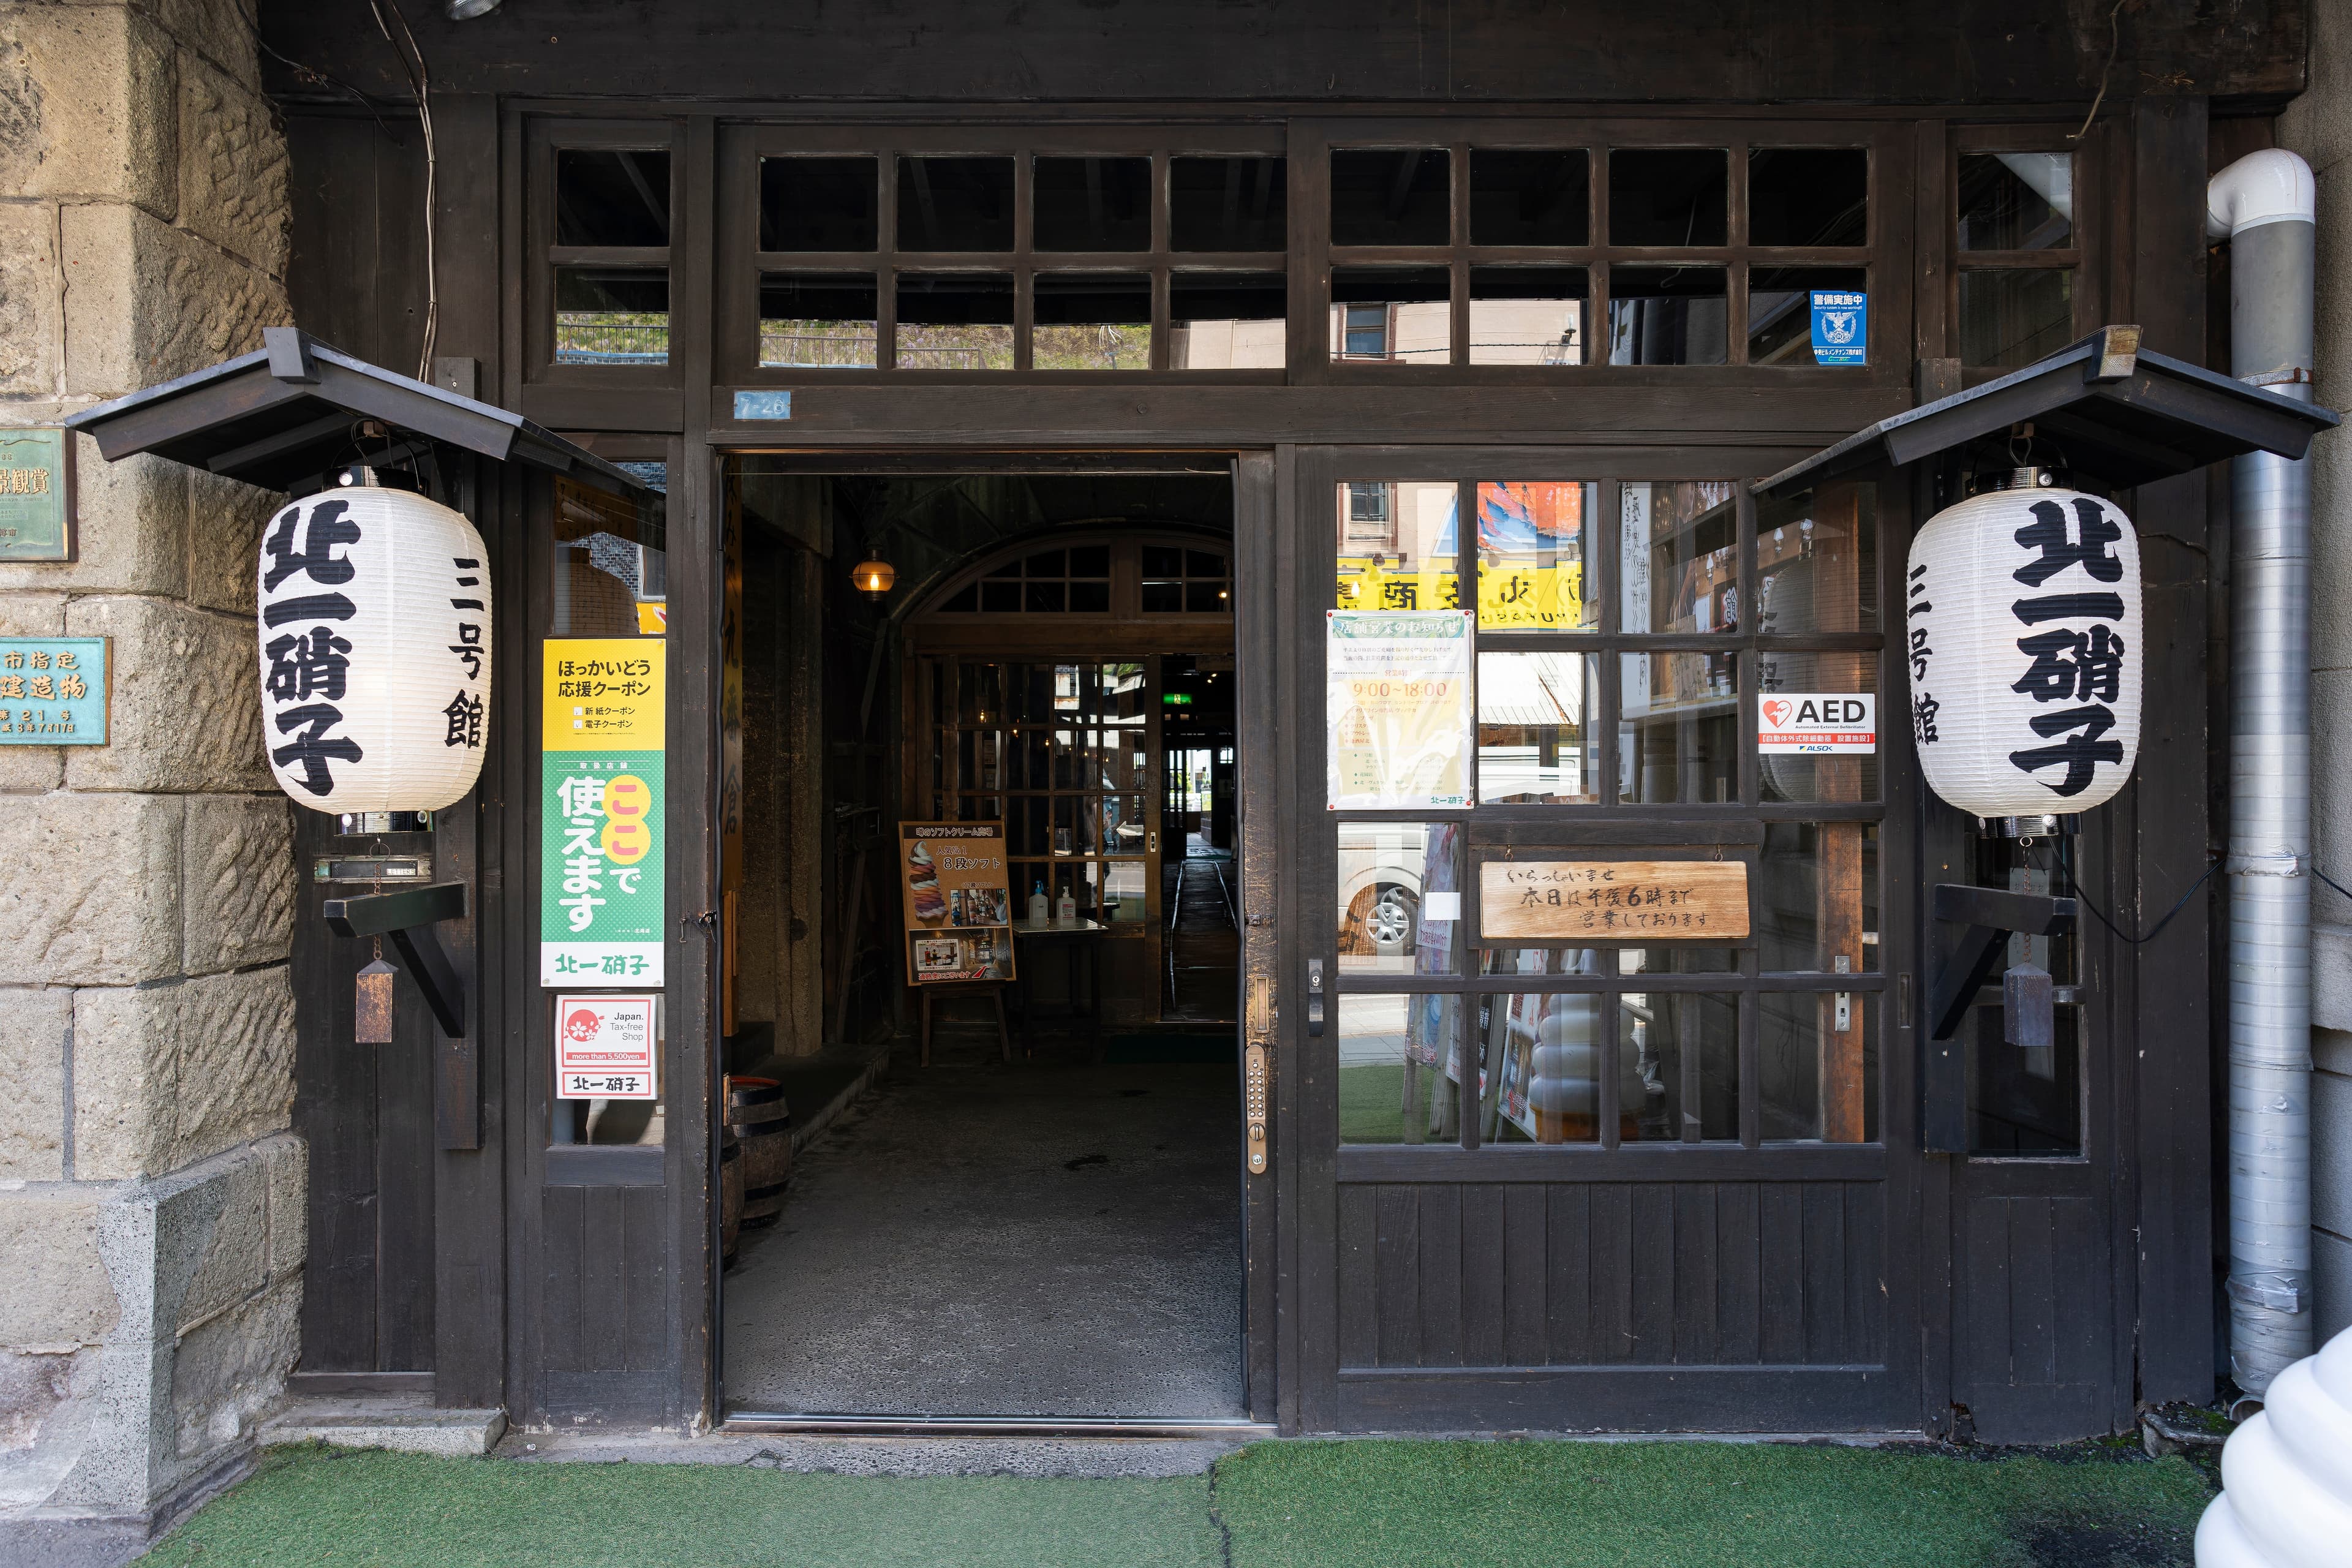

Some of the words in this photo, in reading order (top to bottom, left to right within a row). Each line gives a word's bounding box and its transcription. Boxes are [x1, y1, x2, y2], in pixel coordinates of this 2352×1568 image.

[1814, 294, 1863, 305] 警備実施中
[1341, 620, 1460, 635] 店舗営業のお知らせ
[263, 499, 364, 796] 北一硝子
[442, 557, 485, 748] 三号館
[1908, 564, 1940, 745] 三号館
[2008, 497, 2125, 797] 北一硝子
[3, 650, 80, 670] 市指定
[558, 659, 651, 677] ほっかいどう
[0, 673, 88, 701] 建造物
[558, 680, 651, 698] 応援クーポン
[1796, 700, 1866, 723] AED
[585, 720, 633, 729] 電子クーポン
[556, 775, 607, 933] 使えます
[1507, 869, 1615, 883] いらっしゃいませ
[1520, 886, 1694, 908] 本日は午後6時まで
[555, 953, 650, 976] 北一硝子
[610, 1022, 643, 1031] Tax-free
[622, 1032, 643, 1041] Shop
[573, 1076, 640, 1091] 北一硝子
